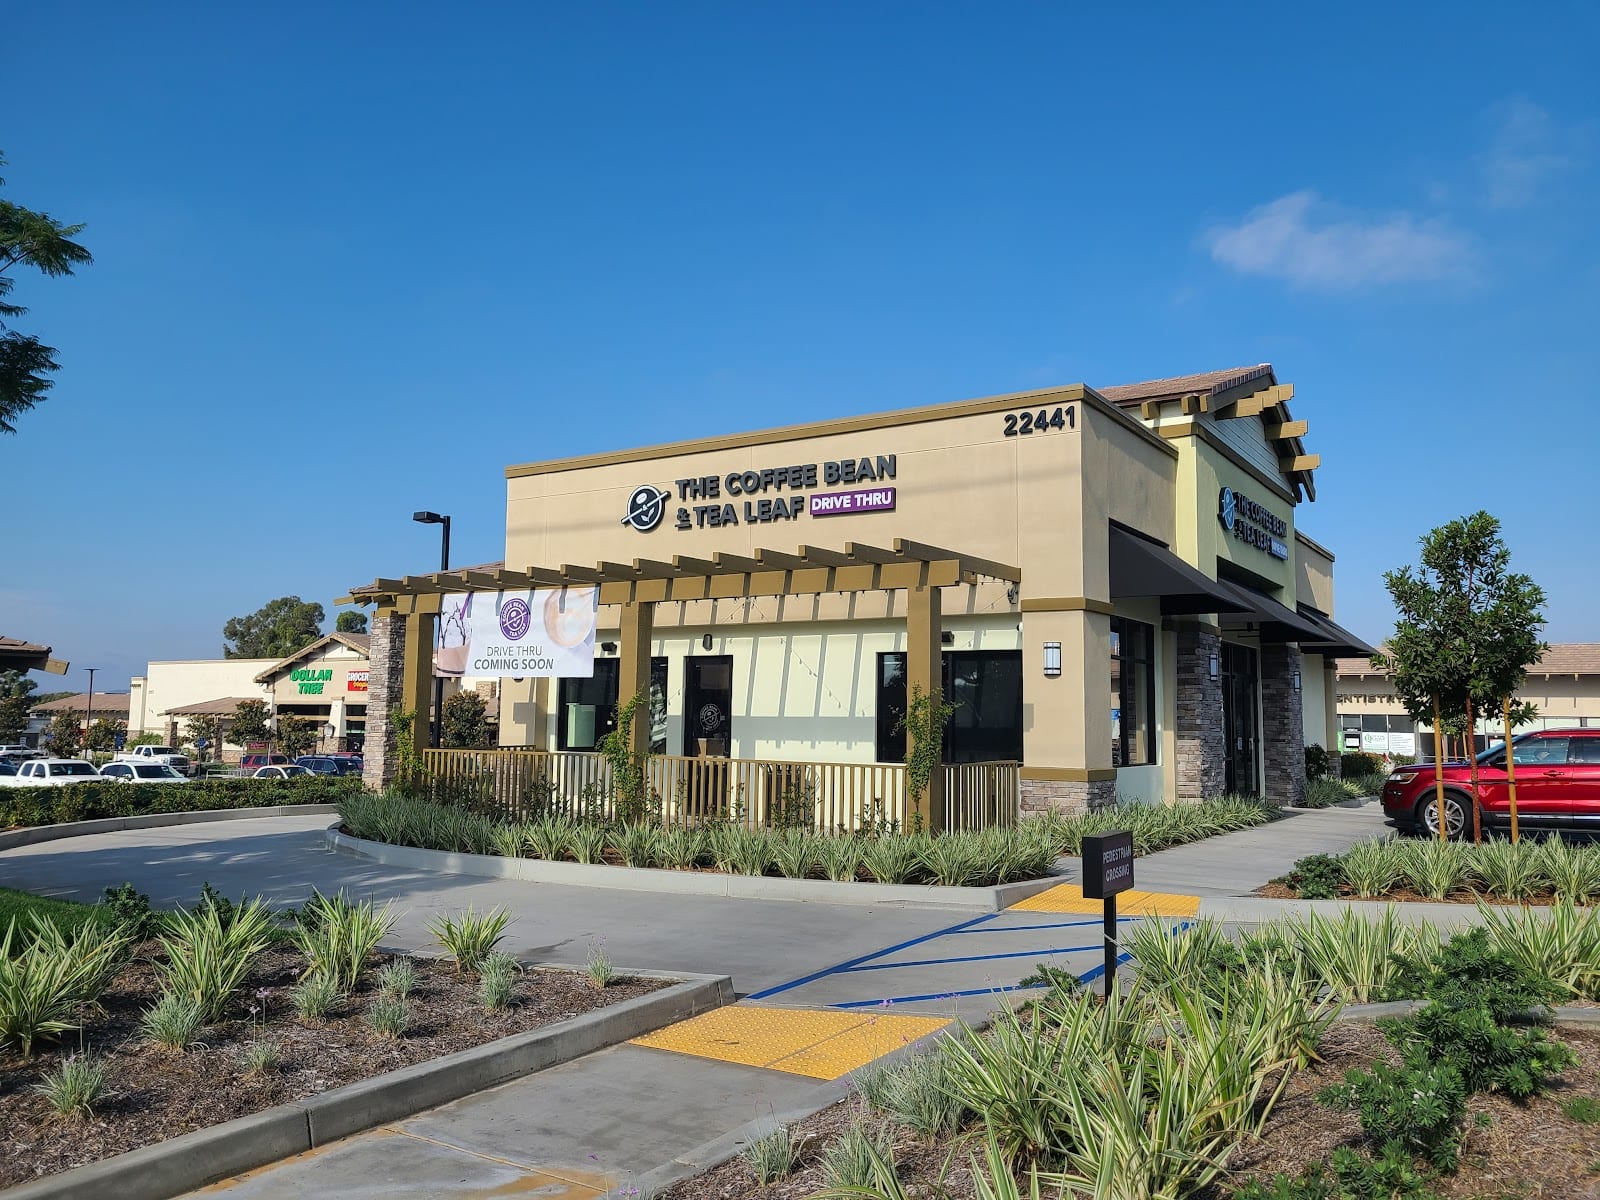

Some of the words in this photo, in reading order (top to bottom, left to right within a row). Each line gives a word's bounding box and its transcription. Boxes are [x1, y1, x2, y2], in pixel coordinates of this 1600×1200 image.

[1003, 405, 1076, 436] 22441
[675, 475, 719, 500] THE
[724, 463, 817, 495] COFFEE
[823, 454, 897, 484] BEAN
[811, 494, 851, 512] DRIVE
[854, 490, 893, 507] THRU
[675, 507, 692, 529] &
[693, 503, 738, 527] TEA
[744, 495, 806, 523] LEAF
[1251, 502, 1273, 532] COFFEE
[487, 646, 514, 657] DRIVE
[516, 645, 542, 656] THRU
[474, 658, 519, 670] COMING
[521, 658, 554, 670] SOON
[291, 669, 332, 681] DOLLAR
[298, 682, 324, 695] TREE
[1103, 845, 1131, 864] PEDESTRIAN
[1105, 864, 1130, 882] CROSSING
